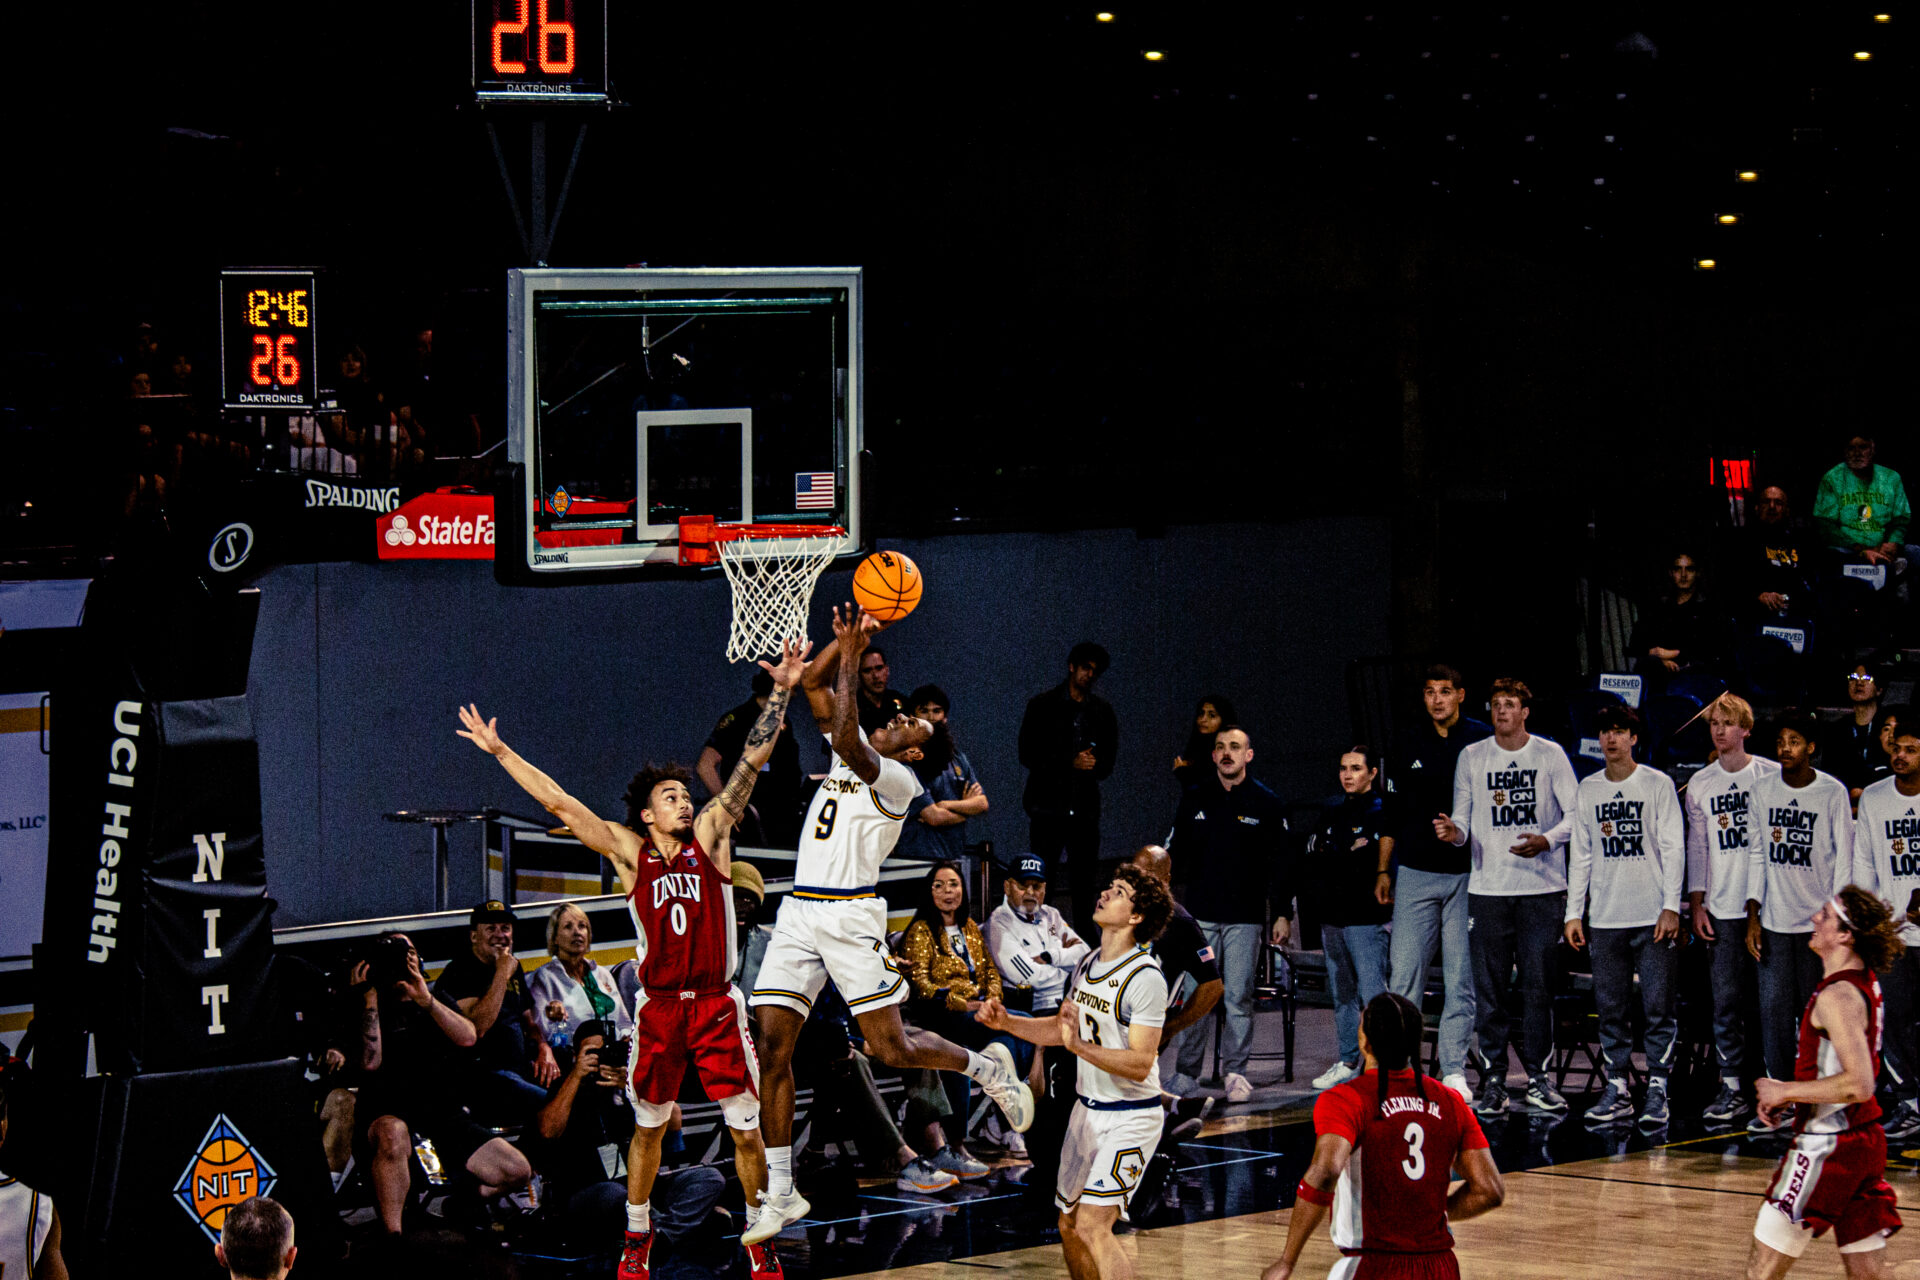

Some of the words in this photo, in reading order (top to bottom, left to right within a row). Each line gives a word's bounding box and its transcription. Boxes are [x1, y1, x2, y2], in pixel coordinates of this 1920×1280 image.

[491, 0, 575, 74] 26
[507, 84, 572, 94] DAKTRONICS
[248, 289, 308, 328] 12:46
[251, 334, 300, 385] 26
[240, 394, 304, 403] DAKTRONICS
[305, 479, 399, 513] SPALDING
[534, 552, 568, 565] SPALDING
[1851, 566, 1880, 576] RESERVED
[1602, 678, 1640, 688] RESERVED
[108, 700, 143, 788] UCI
[1487, 769, 1538, 791] LEGACY
[814, 797, 838, 841] 9
[1491, 804, 1538, 827] LOCK
[1595, 801, 1645, 823] LEGACY
[1769, 807, 1818, 831] LEGACY
[1601, 836, 1645, 857] LOCK
[1769, 842, 1812, 867] LOCK
[1021, 859, 1042, 872] ZOT
[87, 802, 132, 964] Health
[652, 873, 701, 909] UNLV
[670, 902, 687, 936] 0
[1076, 990, 1111, 1014] IRVINE
[1402, 1122, 1425, 1180] 3
[198, 1169, 254, 1201] NIT
